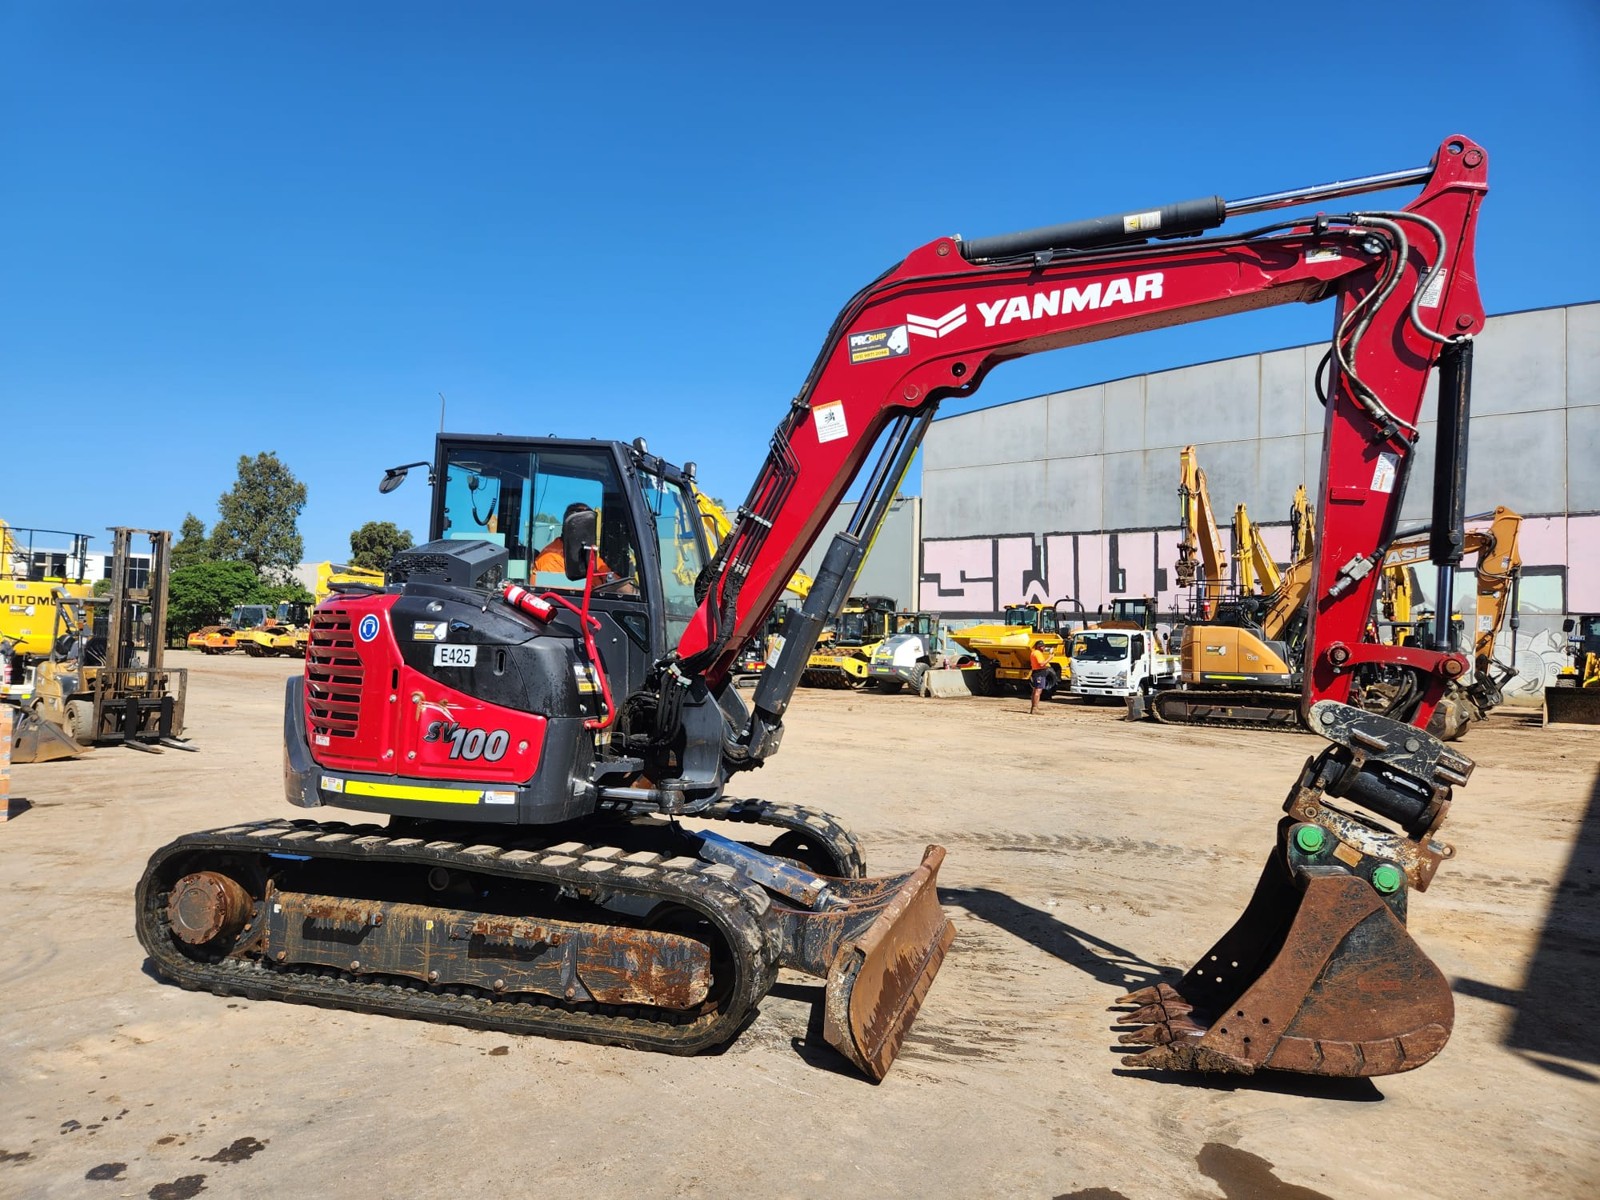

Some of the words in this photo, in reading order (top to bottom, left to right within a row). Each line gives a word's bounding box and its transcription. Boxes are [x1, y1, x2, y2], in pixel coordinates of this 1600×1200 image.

[976, 272, 1164, 327] YANMAR
[1384, 545, 1430, 564] ASE
[441, 648, 471, 664] E425
